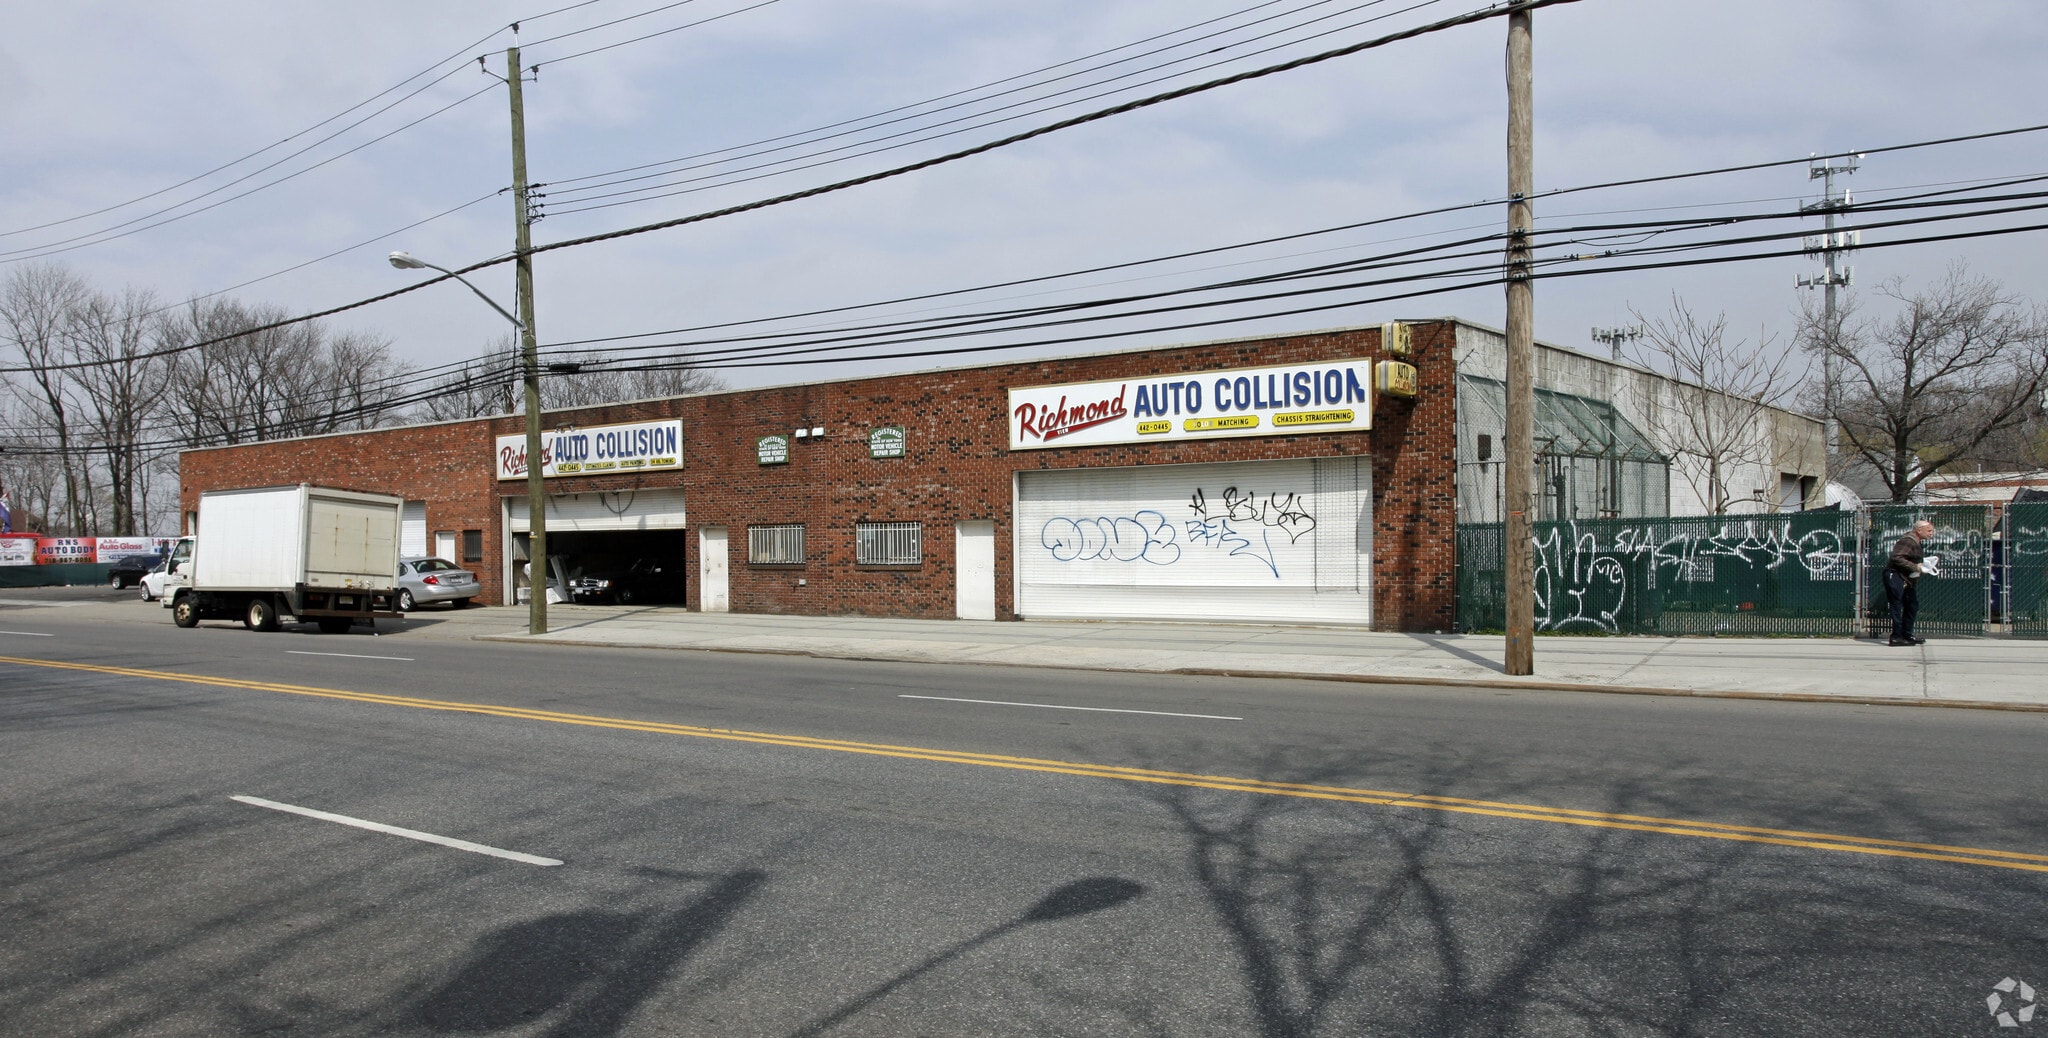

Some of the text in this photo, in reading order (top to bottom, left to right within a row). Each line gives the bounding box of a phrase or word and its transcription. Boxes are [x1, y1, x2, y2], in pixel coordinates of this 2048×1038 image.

[1015, 368, 1365, 442] Richmond AUTO COLLISION
[1218, 418, 1249, 427] MATCHING
[1276, 412, 1352, 423] CHASSIS STRAIGHTENING
[1139, 423, 1169, 431] 442-0445
[871, 428, 903, 440] REGISTERED
[555, 434, 588, 462] AUTO
[596, 426, 677, 459] COLLISION
[759, 436, 787, 447] REGISTERED
[41, 546, 68, 554] AUTO
[70, 546, 95, 554] BODY
[120, 542, 143, 550] Glass
